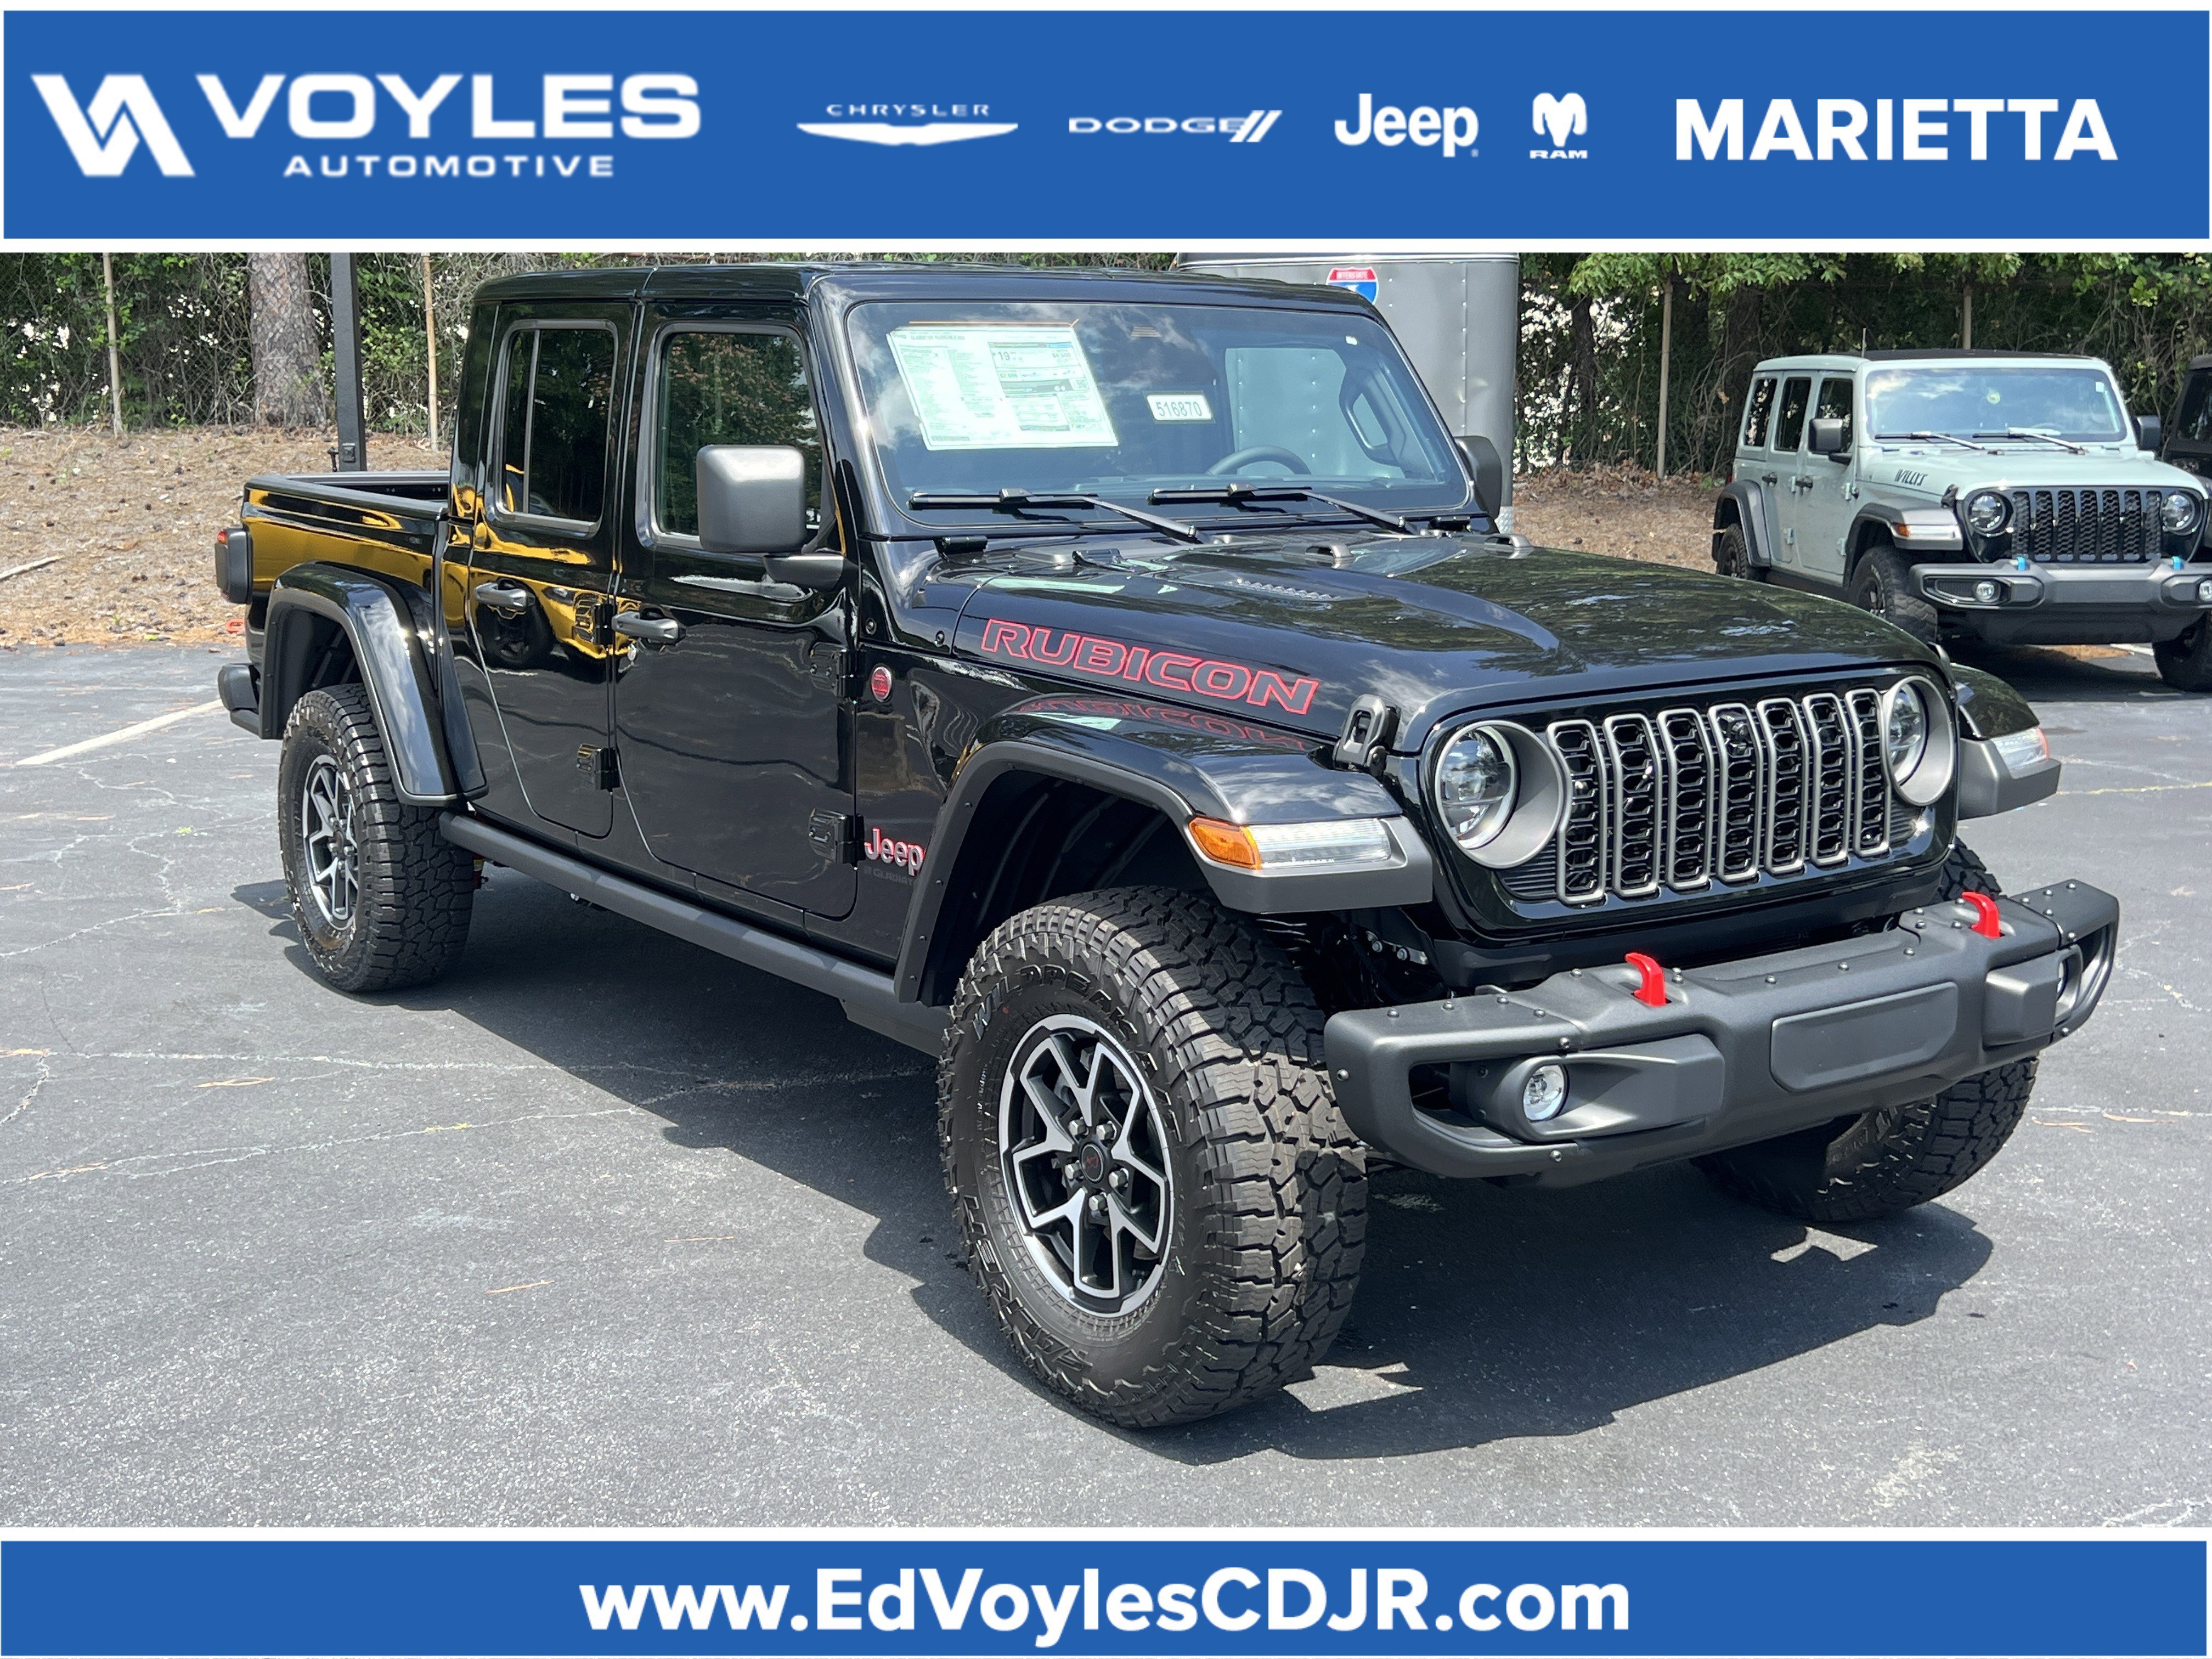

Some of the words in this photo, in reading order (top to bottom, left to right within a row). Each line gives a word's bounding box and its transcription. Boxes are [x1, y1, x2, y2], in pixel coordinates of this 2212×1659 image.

[1155, 400, 1203, 417] 516870
[980, 618, 1319, 715] RUBICON
[864, 827, 925, 877] Jeep
[972, 963, 1138, 1041] WILDPEAK
